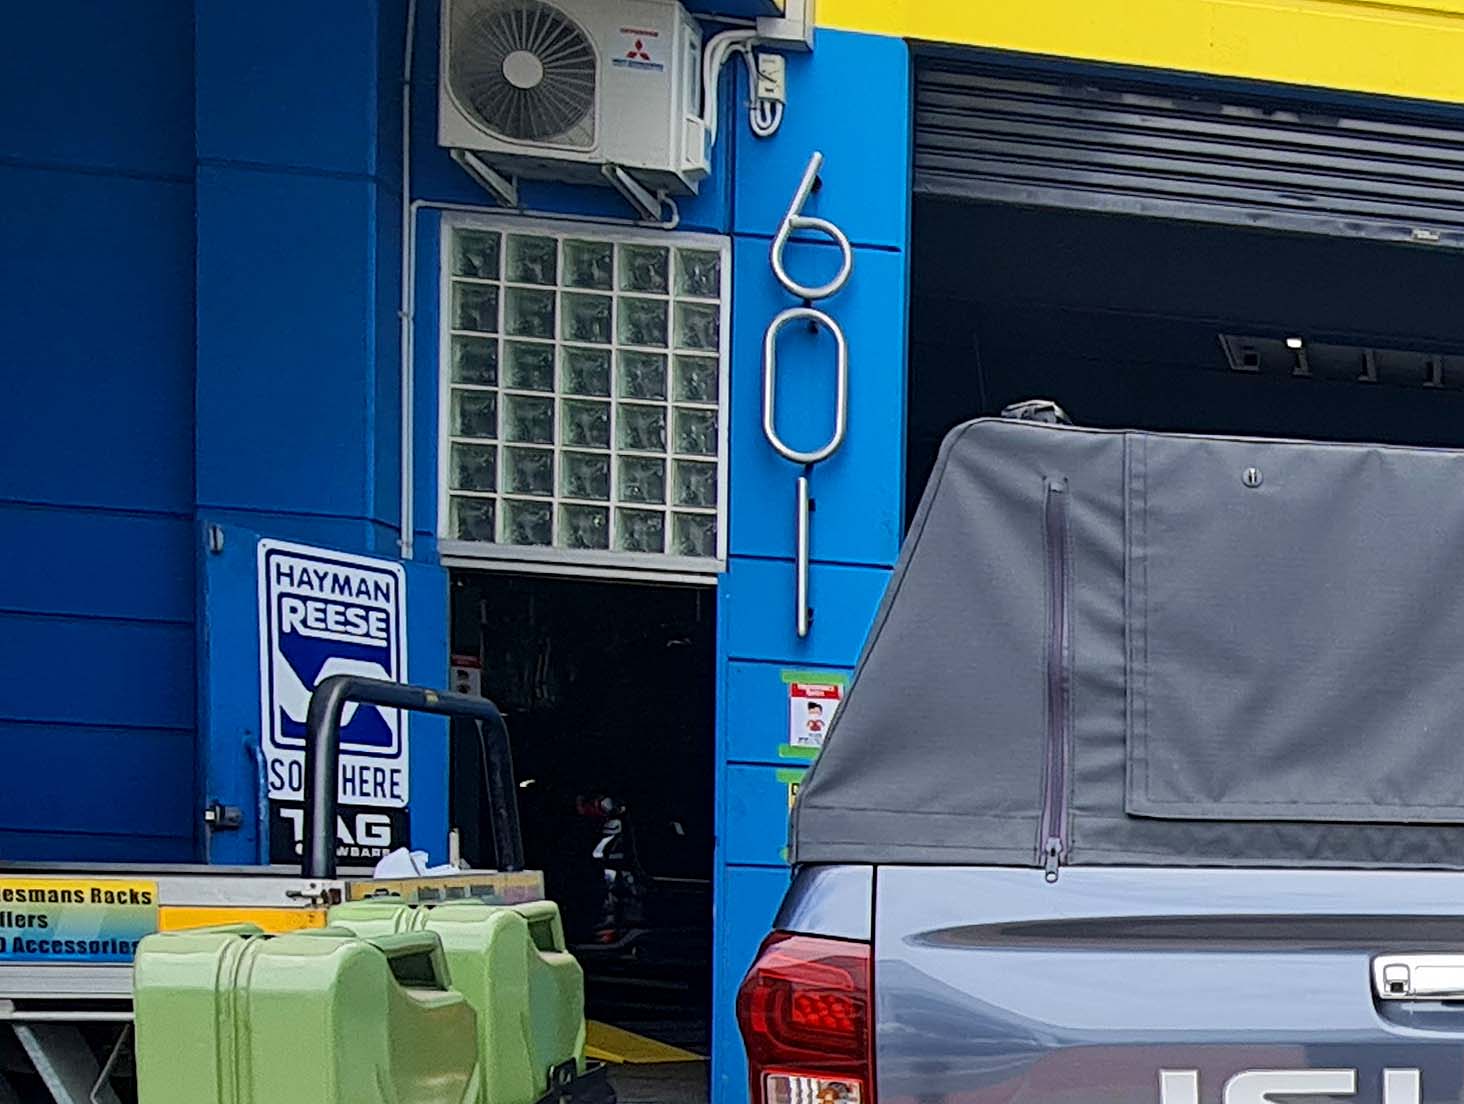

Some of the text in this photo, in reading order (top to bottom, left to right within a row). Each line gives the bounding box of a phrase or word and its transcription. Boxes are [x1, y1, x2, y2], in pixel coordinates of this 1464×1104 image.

[275, 562, 391, 603] HAYMAN
[281, 597, 388, 641] REESE
[342, 764, 403, 801] HERE
[91, 888, 152, 905] Racks
